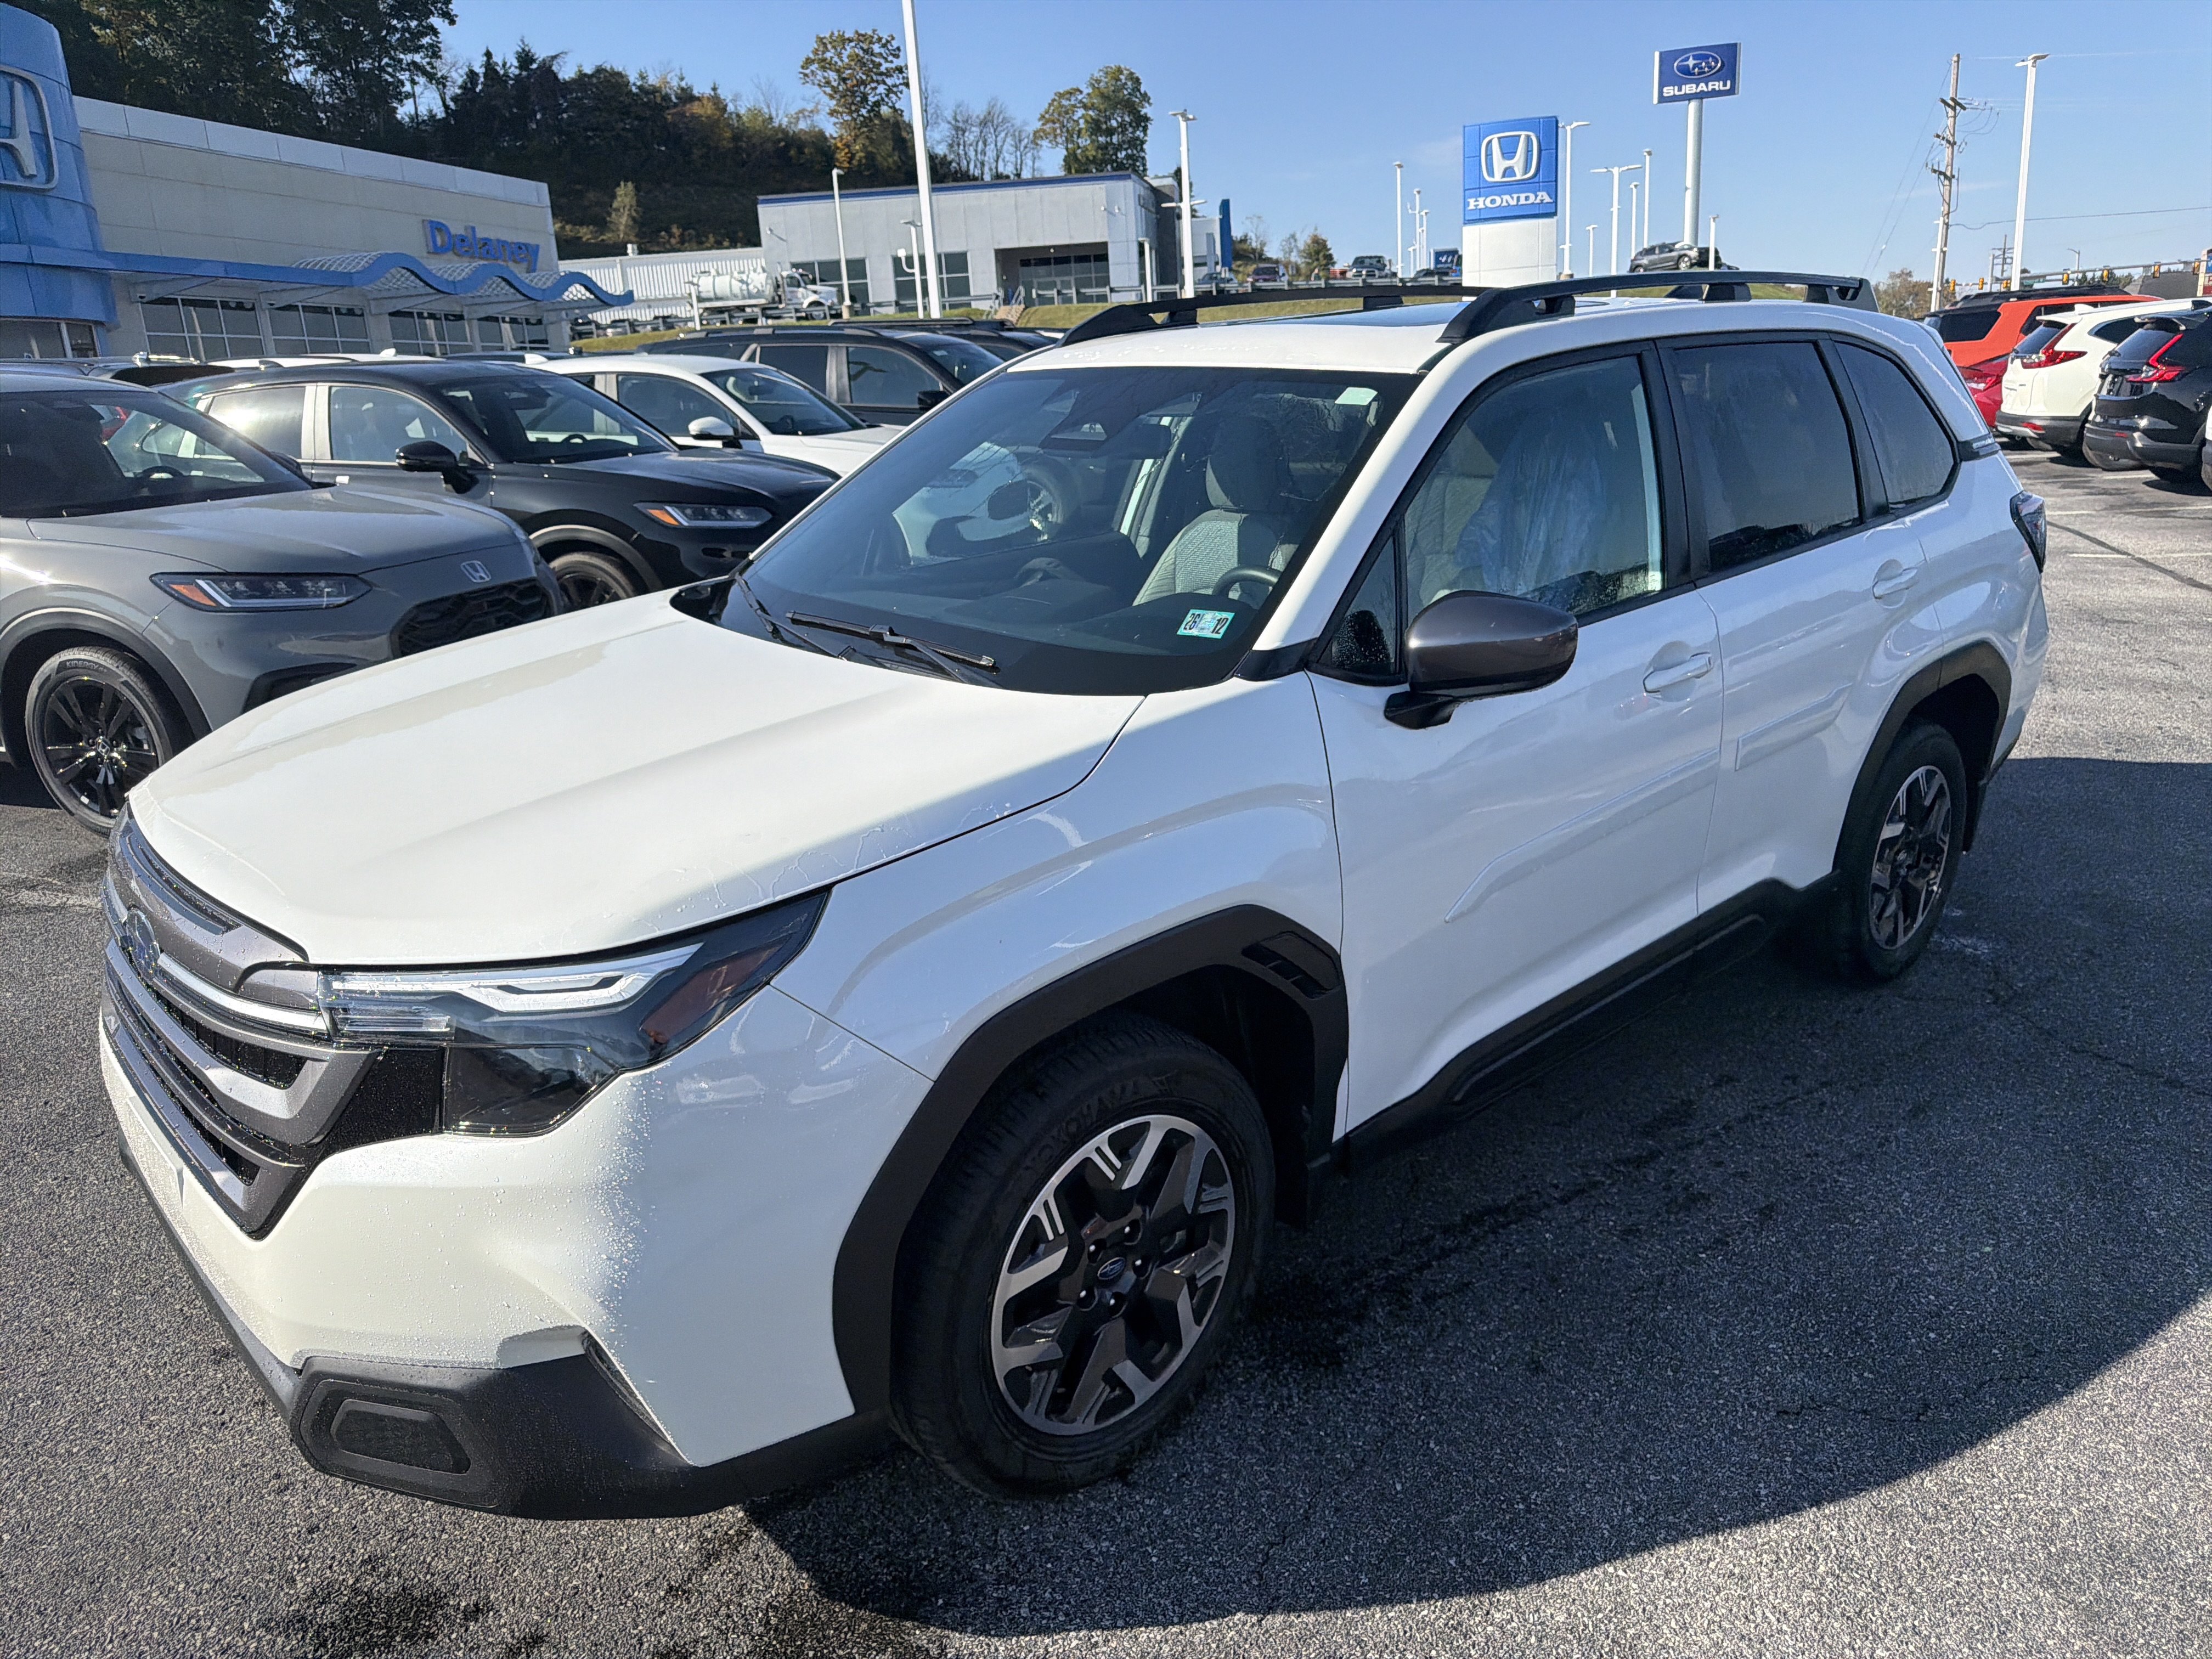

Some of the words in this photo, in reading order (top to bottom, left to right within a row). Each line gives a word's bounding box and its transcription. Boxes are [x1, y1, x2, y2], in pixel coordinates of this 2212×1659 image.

[1663, 80, 1731, 97] SUBARU
[1467, 191, 1554, 210] HONDA
[423, 219, 540, 273] Delaney
[1183, 613, 1200, 630] 26
[1211, 617, 1229, 634] 12
[66, 661, 99, 670] KINERGY
